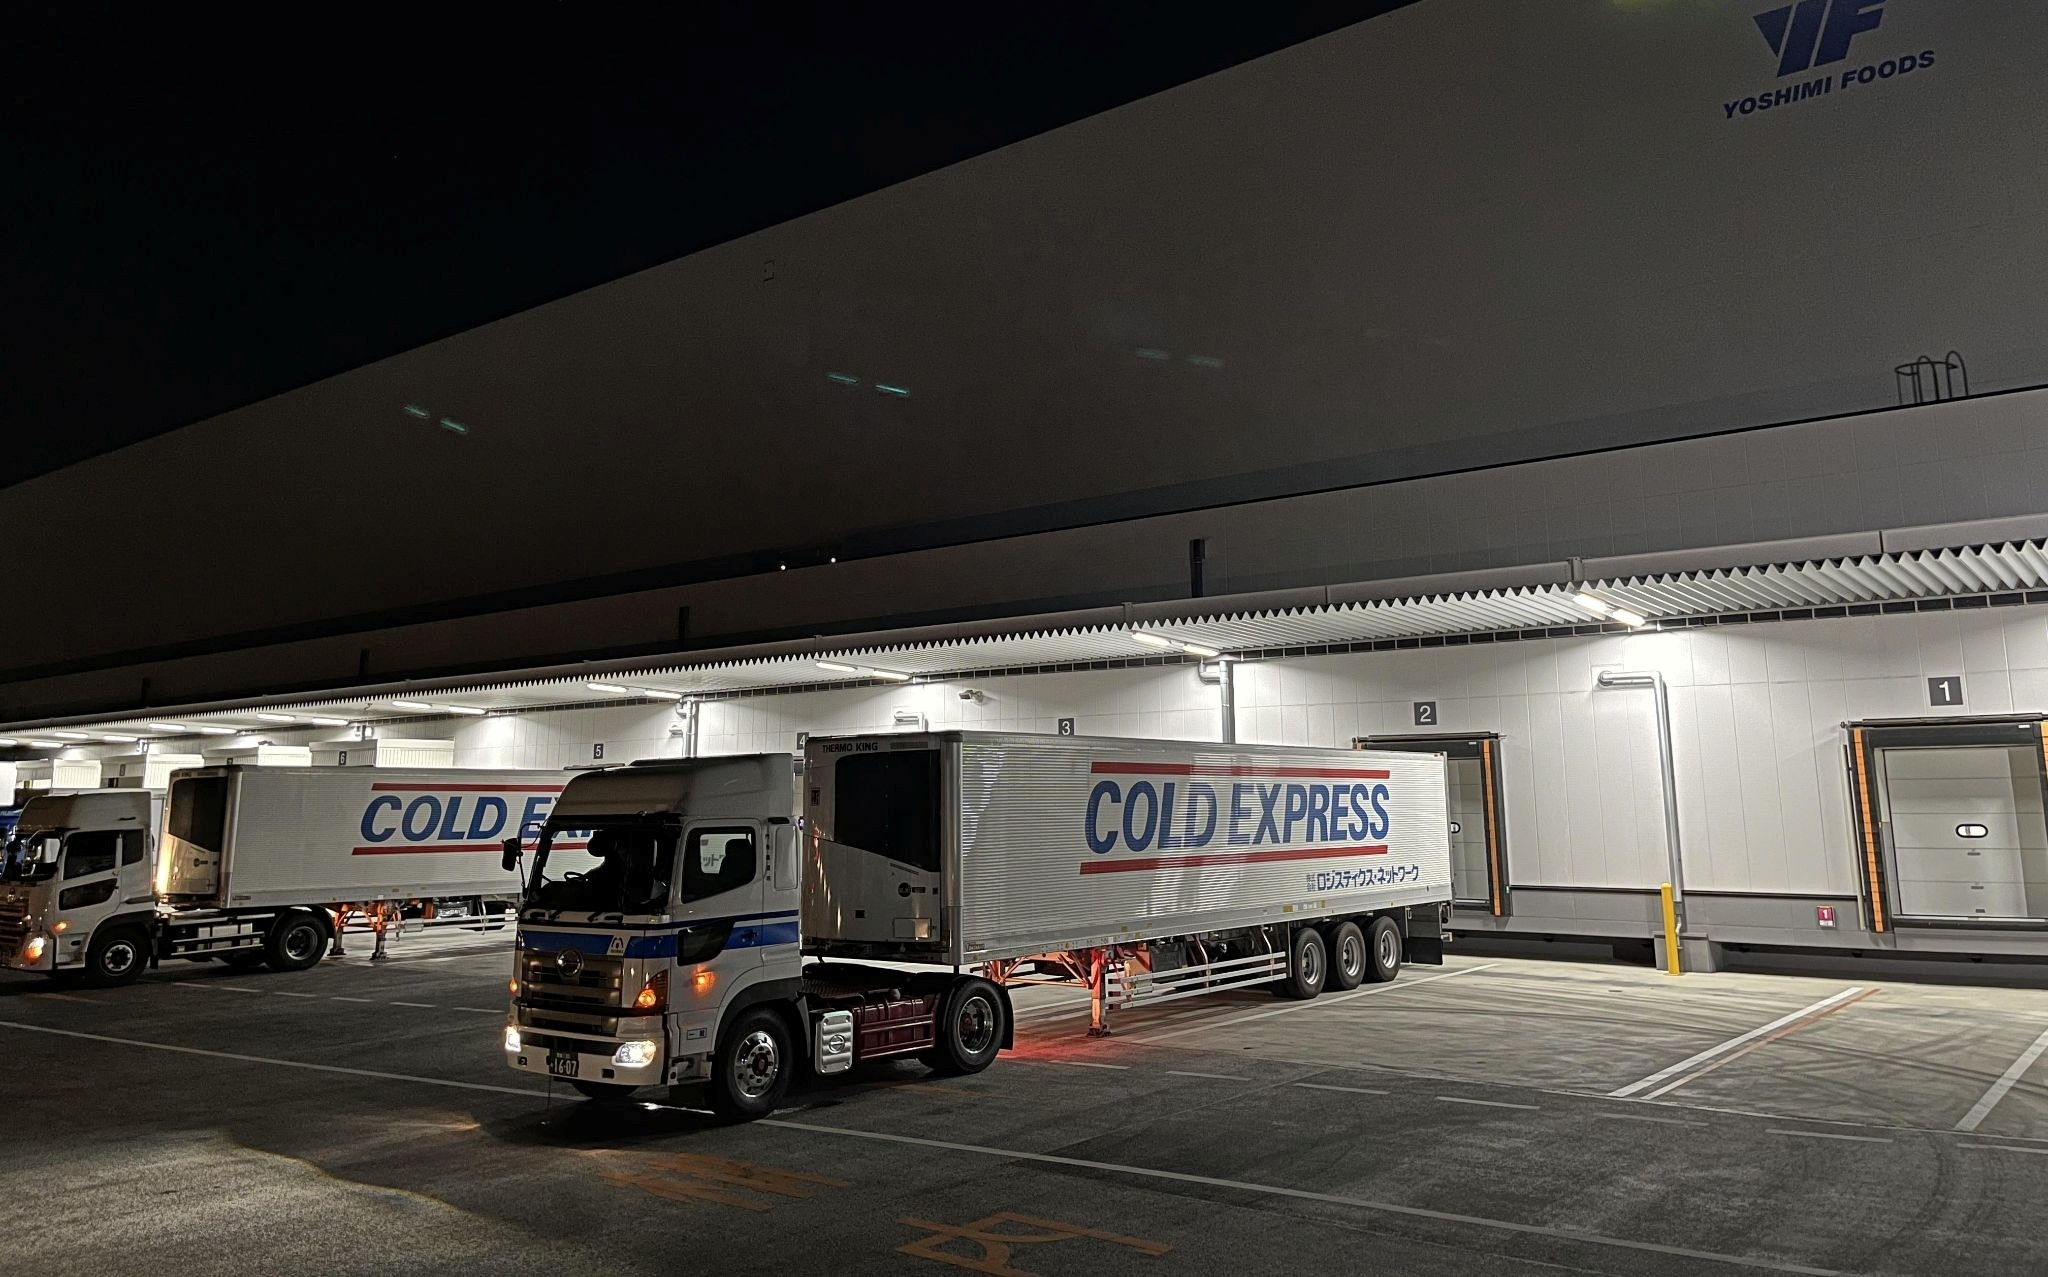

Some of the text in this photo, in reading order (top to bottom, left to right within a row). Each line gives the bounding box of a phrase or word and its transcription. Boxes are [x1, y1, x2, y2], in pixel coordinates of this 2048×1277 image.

[1723, 50, 1936, 119] YOSHIMI FOODS
[1939, 680, 1950, 702] 1
[1420, 705, 1431, 722] 2
[1062, 720, 1070, 735] 3
[822, 743, 853, 753] THERMO
[856, 742, 879, 752] KING
[360, 795, 508, 842] COLD
[1085, 781, 1390, 854] COLD EXPRESS
